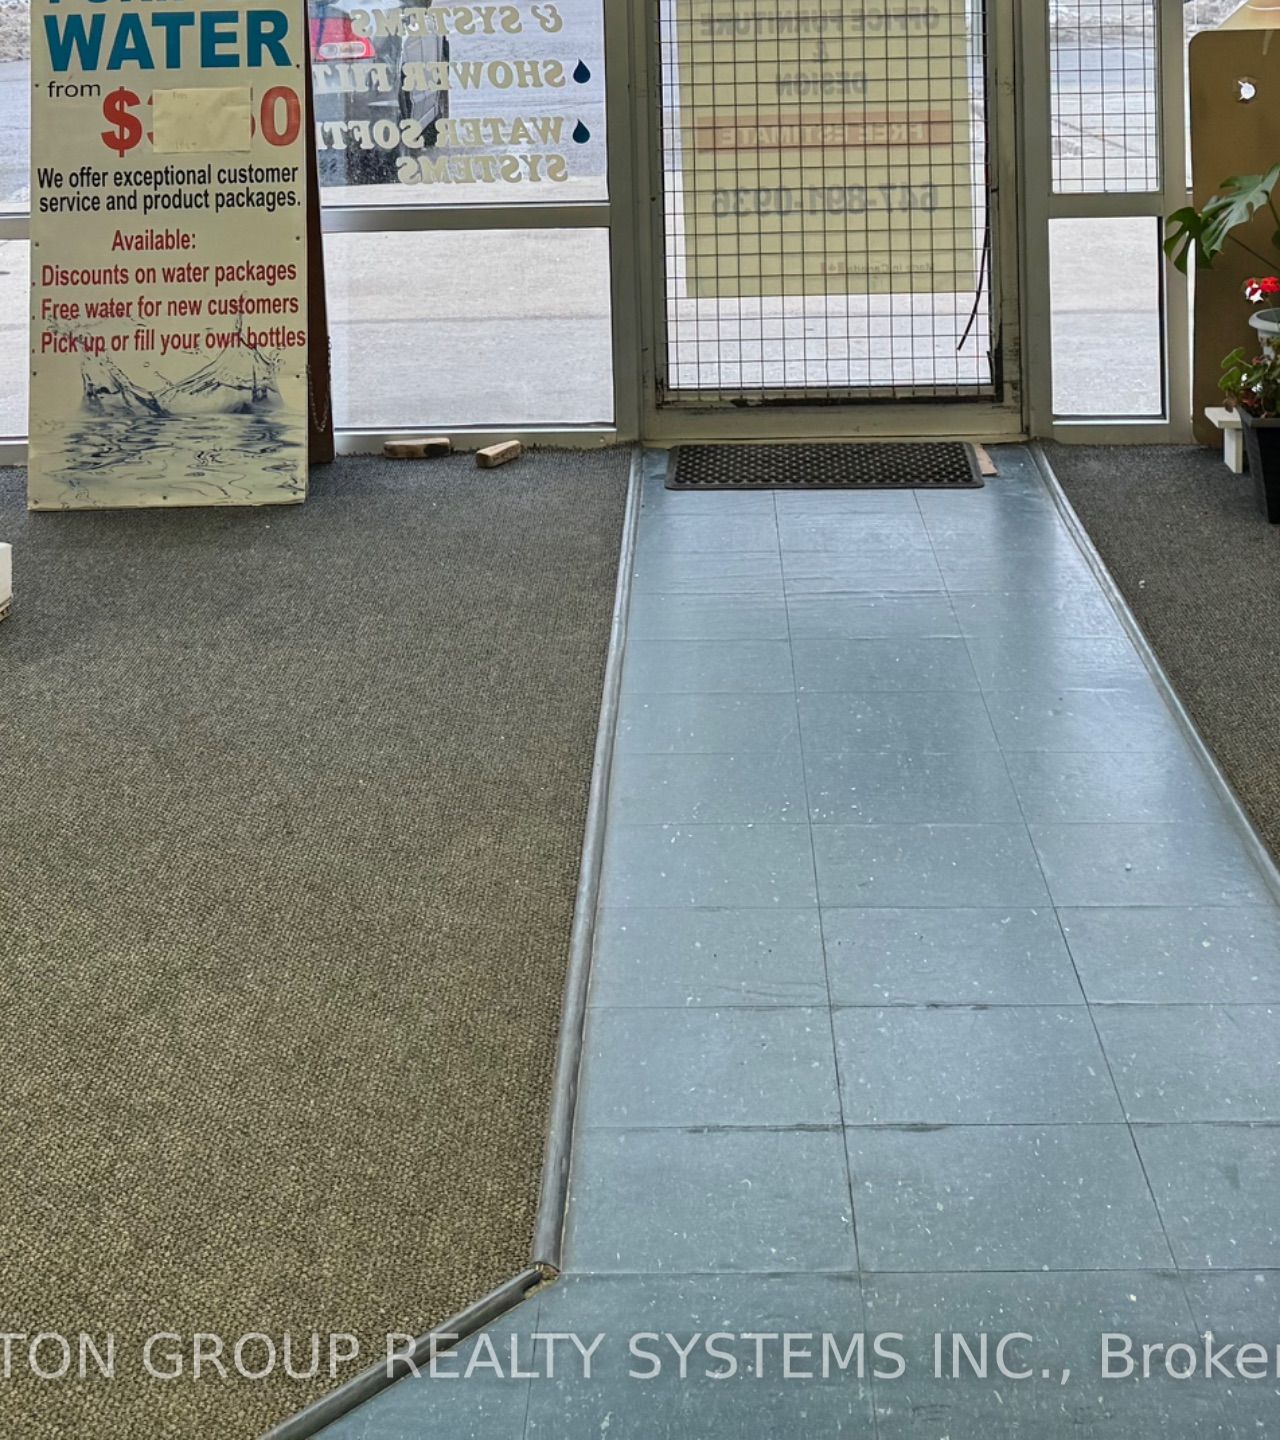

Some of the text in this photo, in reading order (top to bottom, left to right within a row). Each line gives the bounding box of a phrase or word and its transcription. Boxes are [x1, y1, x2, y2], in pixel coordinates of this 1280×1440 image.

[43, 10, 292, 72] WATER
[48, 80, 102, 98] from
[37, 164, 299, 190] We offer exceptional customer
[39, 186, 301, 215] service and product packages.
[111, 229, 197, 251] Available:
[41, 260, 297, 287] Discounts on water packages
[40, 295, 299, 320] Free water for new customers
[40, 326, 306, 357] Pick up or fill your own bottles
